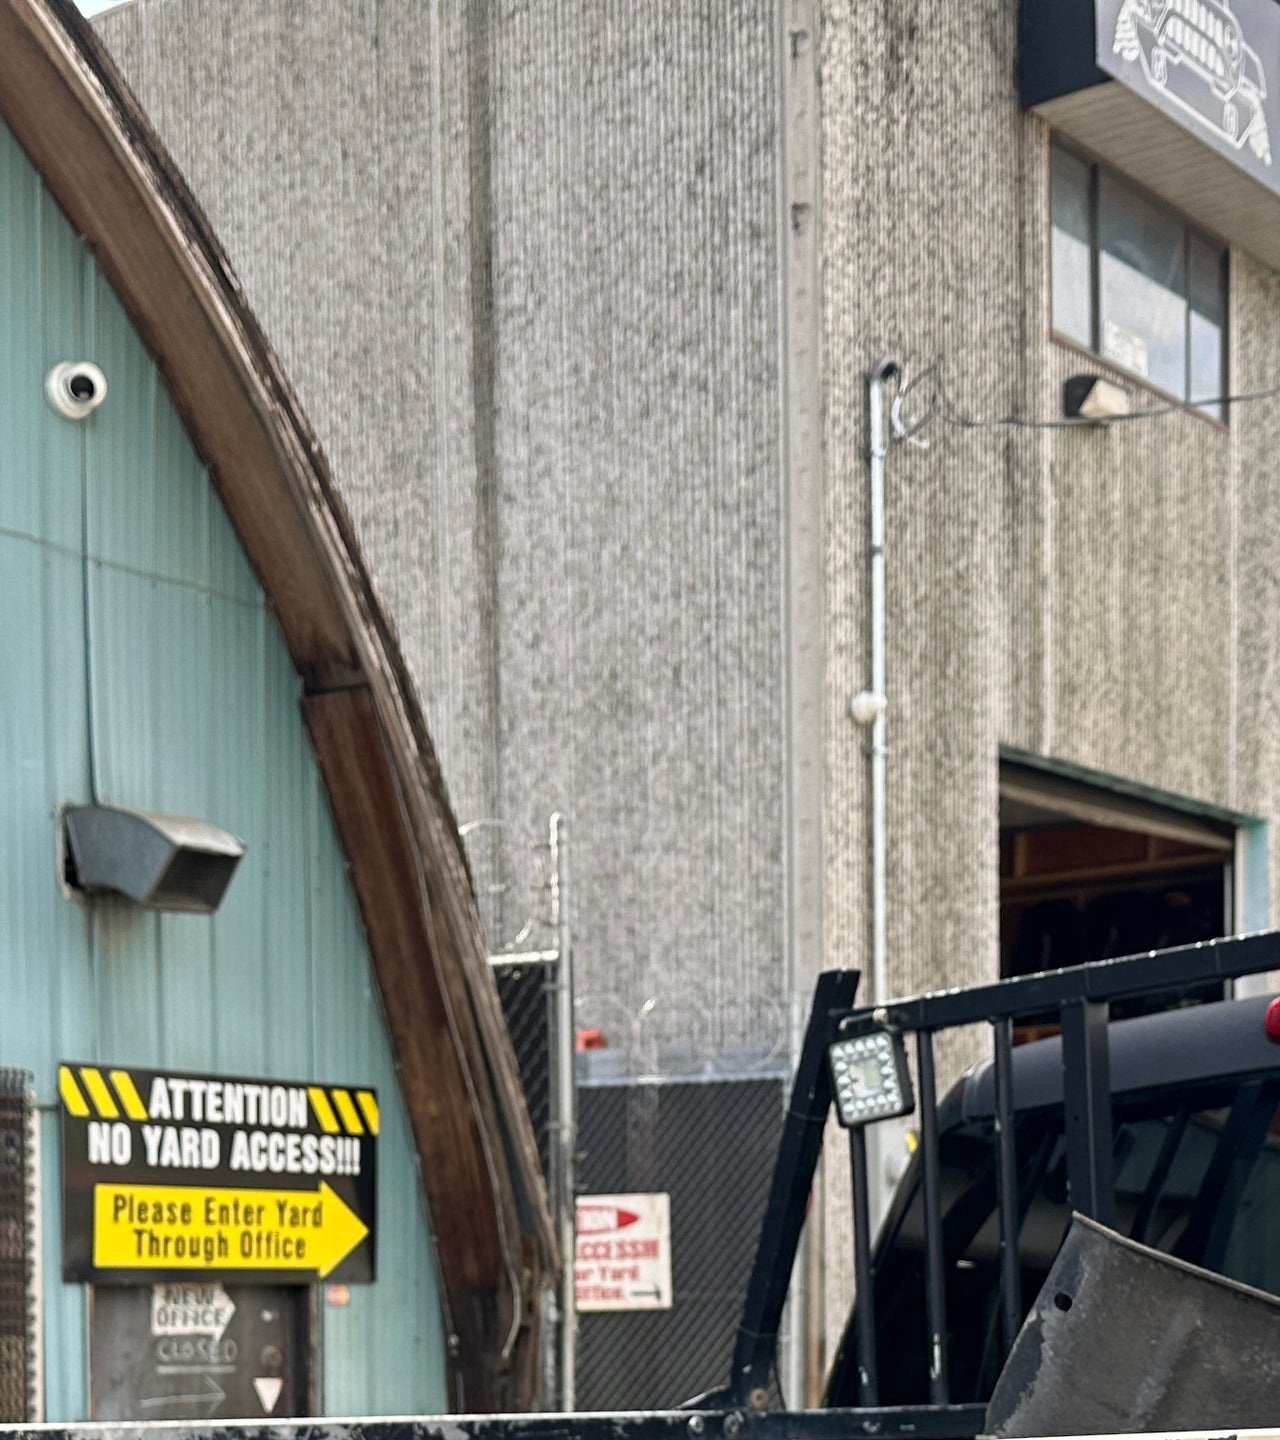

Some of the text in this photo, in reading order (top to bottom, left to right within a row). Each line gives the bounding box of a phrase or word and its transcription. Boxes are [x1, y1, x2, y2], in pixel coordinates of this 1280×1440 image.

[148, 1076, 309, 1129] ATTENTION
[87, 1121, 362, 1176] NO YARD ACCESS!!!
[113, 1195, 324, 1228] Please Enter Yard
[133, 1228, 306, 1263] Through Office
[157, 1306, 225, 1327] OFFICE
